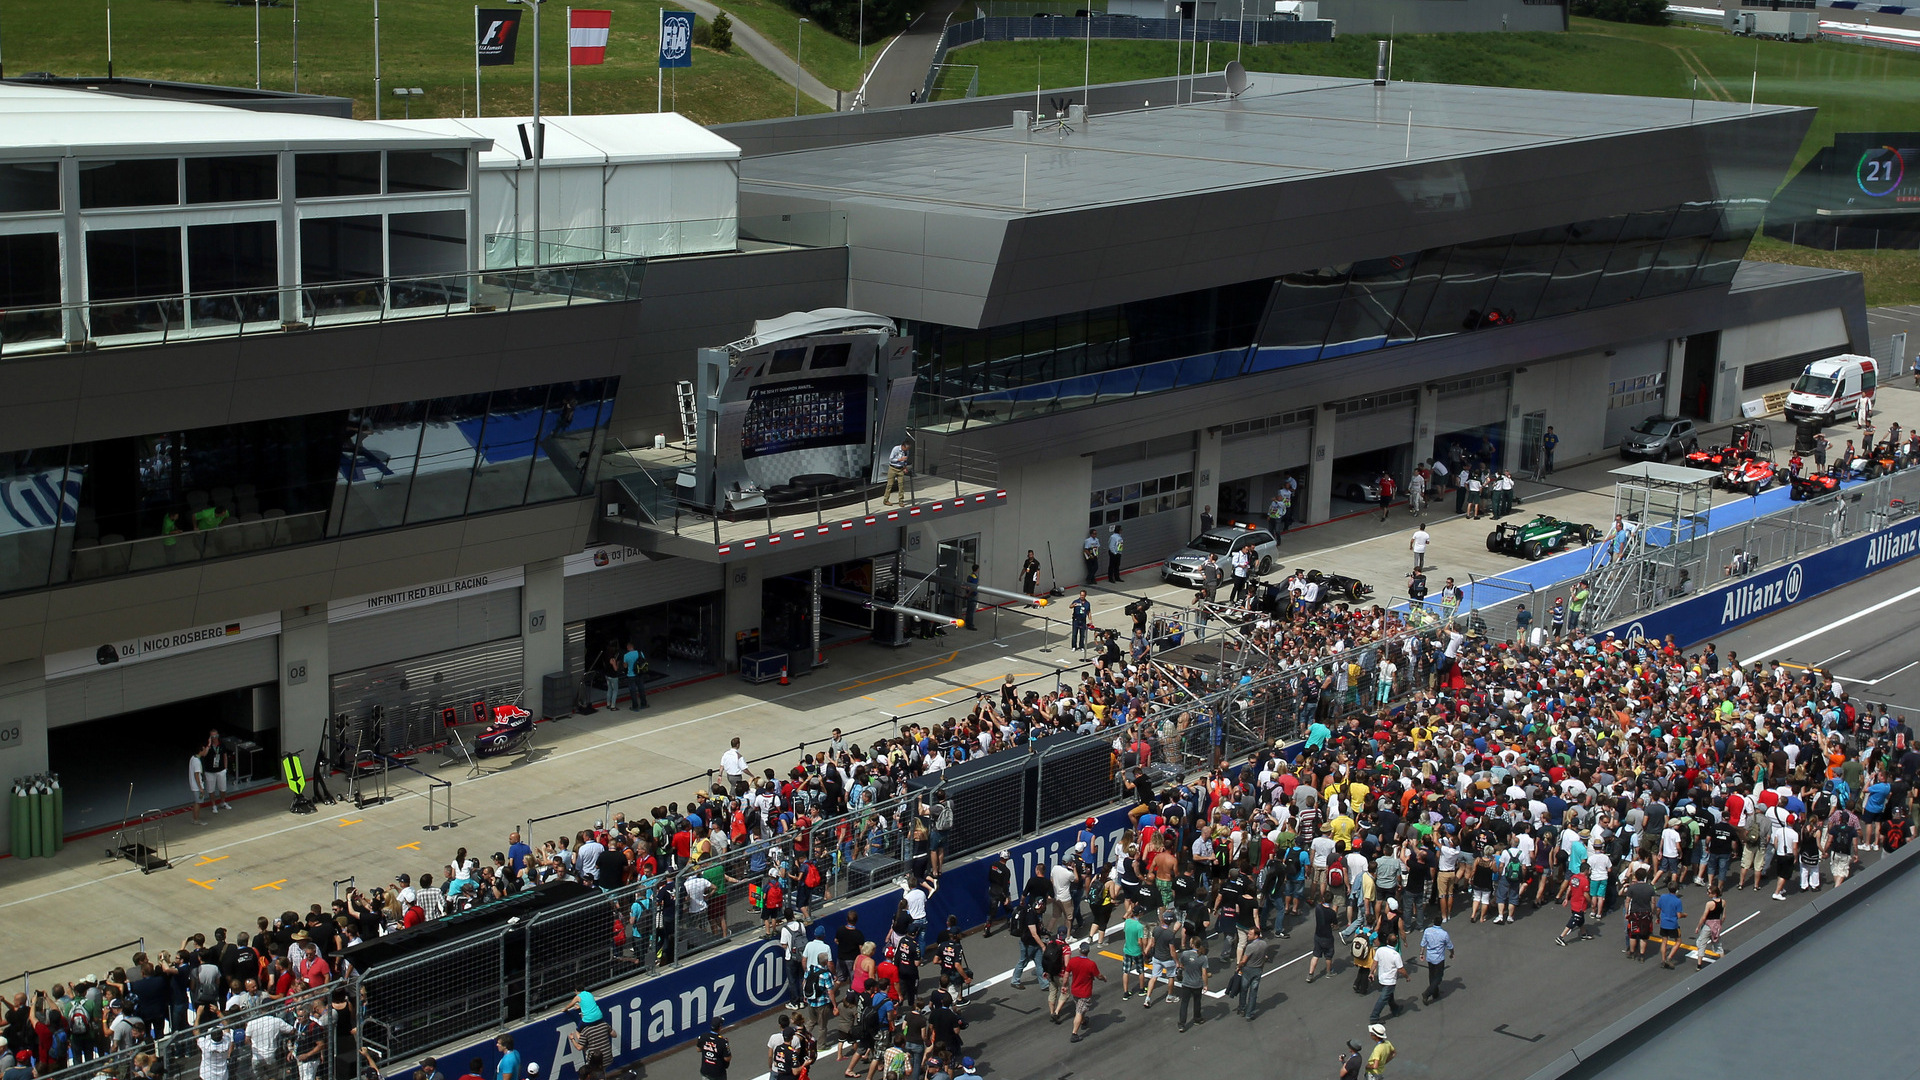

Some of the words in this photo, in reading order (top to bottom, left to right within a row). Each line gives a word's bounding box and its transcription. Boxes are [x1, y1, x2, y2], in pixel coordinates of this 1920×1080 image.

[1866, 161, 1892, 181] 21
[910, 536, 920, 546] 05
[1865, 529, 1918, 569] Allianz
[611, 550, 621, 560] 03
[735, 572, 747, 583] 06
[367, 592, 406, 608] INFINITI
[408, 588, 427, 601] RED
[429, 583, 453, 596] BULL
[455, 576, 488, 591] RACING
[1721, 579, 1784, 625] Allianz
[531, 615, 545, 627] 07
[122, 644, 135, 656] 06
[143, 637, 170, 652] NICO
[172, 627, 223, 647] ROSBERG
[290, 666, 306, 679] 08
[1, 727, 19, 742] 09
[1004, 827, 1125, 902] lliz
[549, 973, 736, 1080] Alianz
